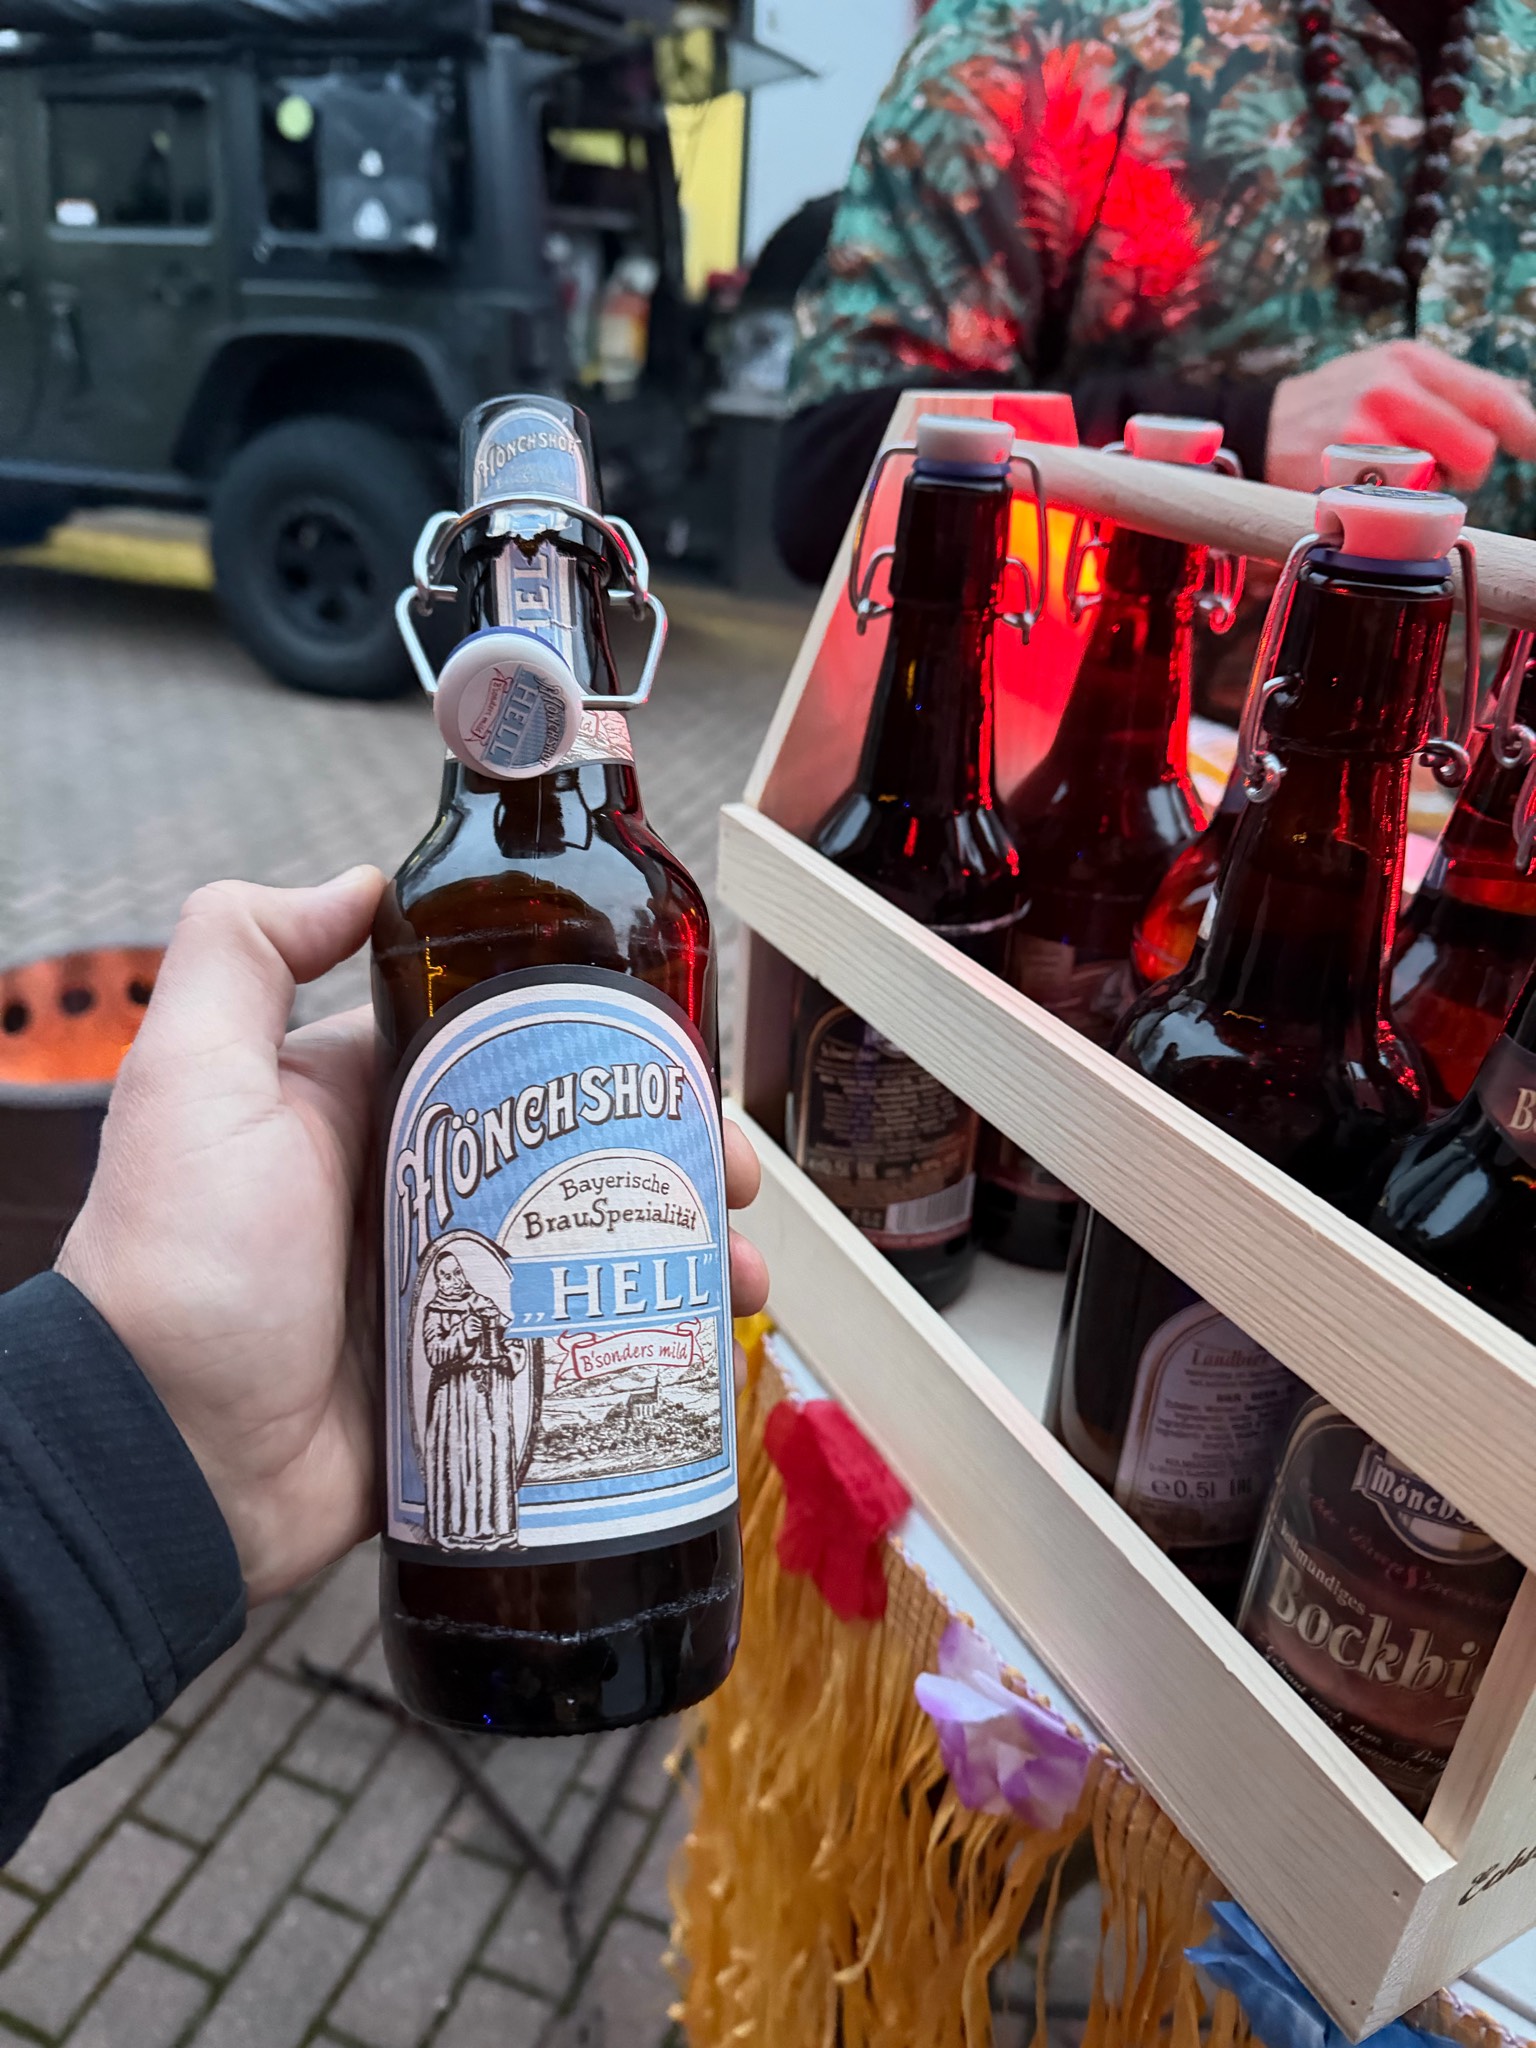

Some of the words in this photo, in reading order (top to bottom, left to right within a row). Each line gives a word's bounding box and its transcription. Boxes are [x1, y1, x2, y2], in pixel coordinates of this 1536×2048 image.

[397, 1062, 686, 1297] MÖNCHSHOF
[558, 1171, 670, 1202] Bayerische
[579, 1342, 654, 1373] B'sonders
[658, 1342, 689, 1361] mild
[1267, 1553, 1486, 1701] Bockbi
